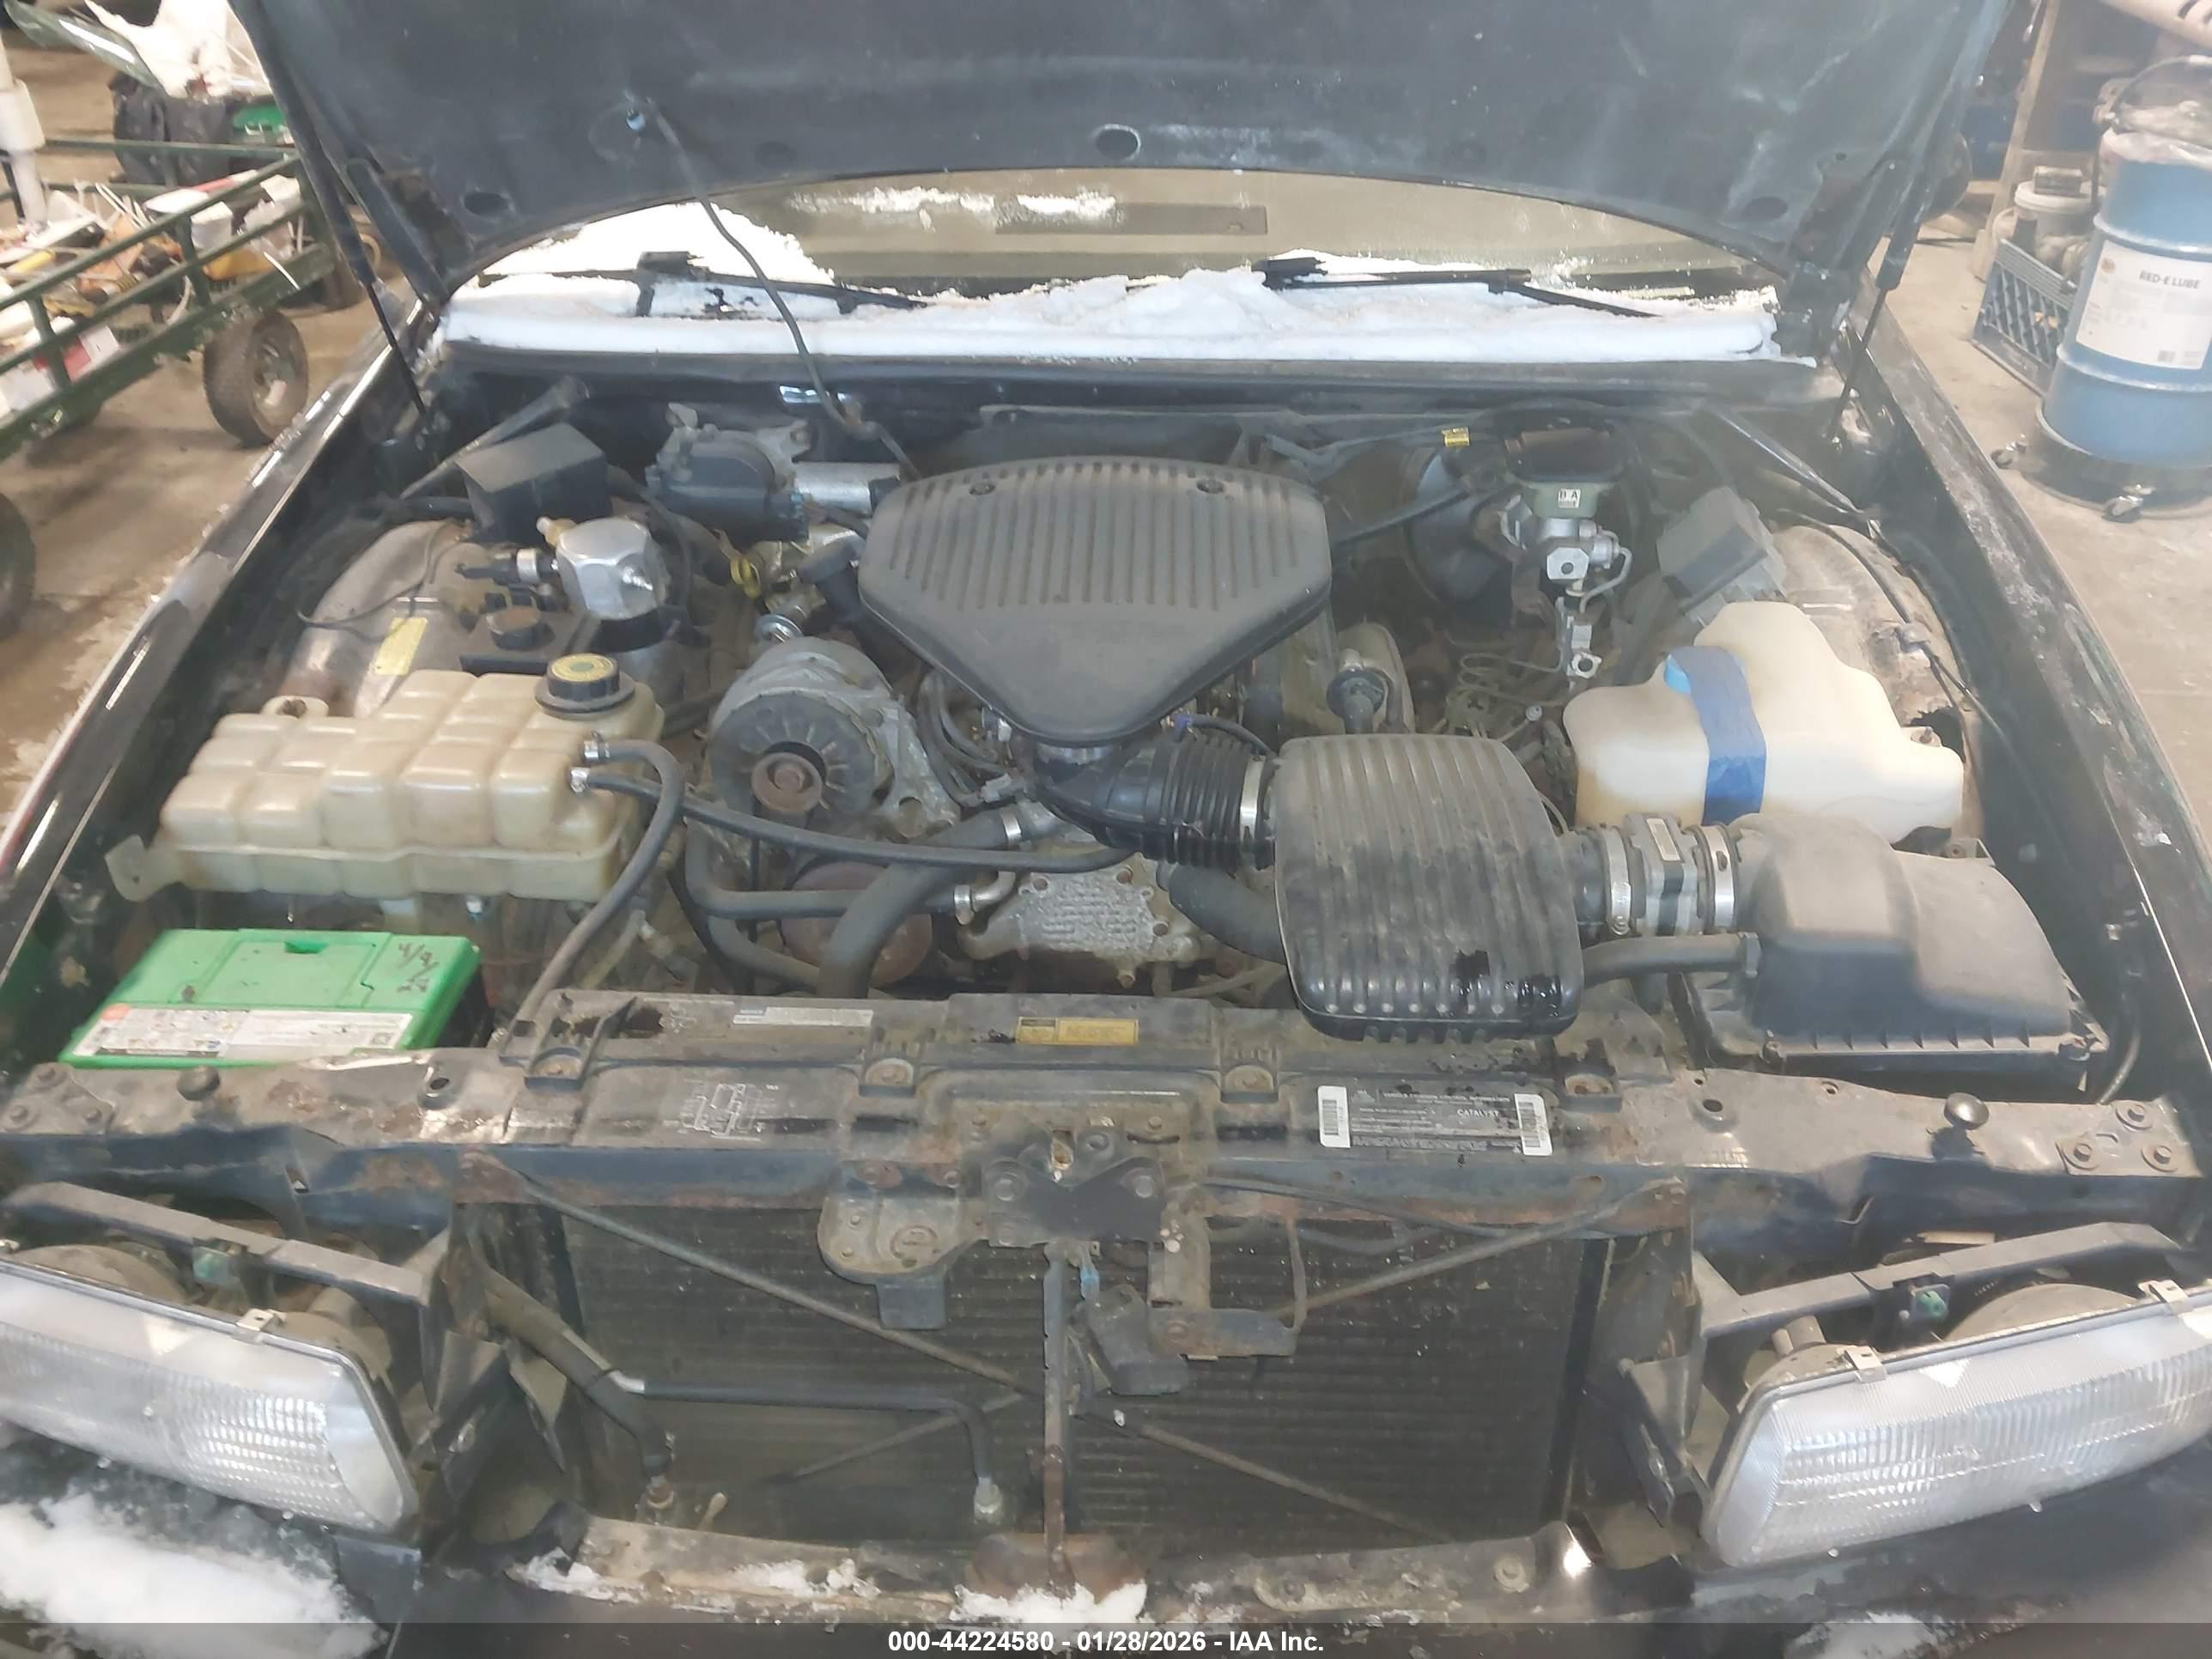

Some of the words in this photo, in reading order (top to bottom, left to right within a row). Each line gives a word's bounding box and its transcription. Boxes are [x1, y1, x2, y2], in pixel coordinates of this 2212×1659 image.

[2139, 270, 2171, 285] RED-E
[2172, 276, 2201, 289] LUBE
[1456, 1109, 1500, 1118] CATALYST
